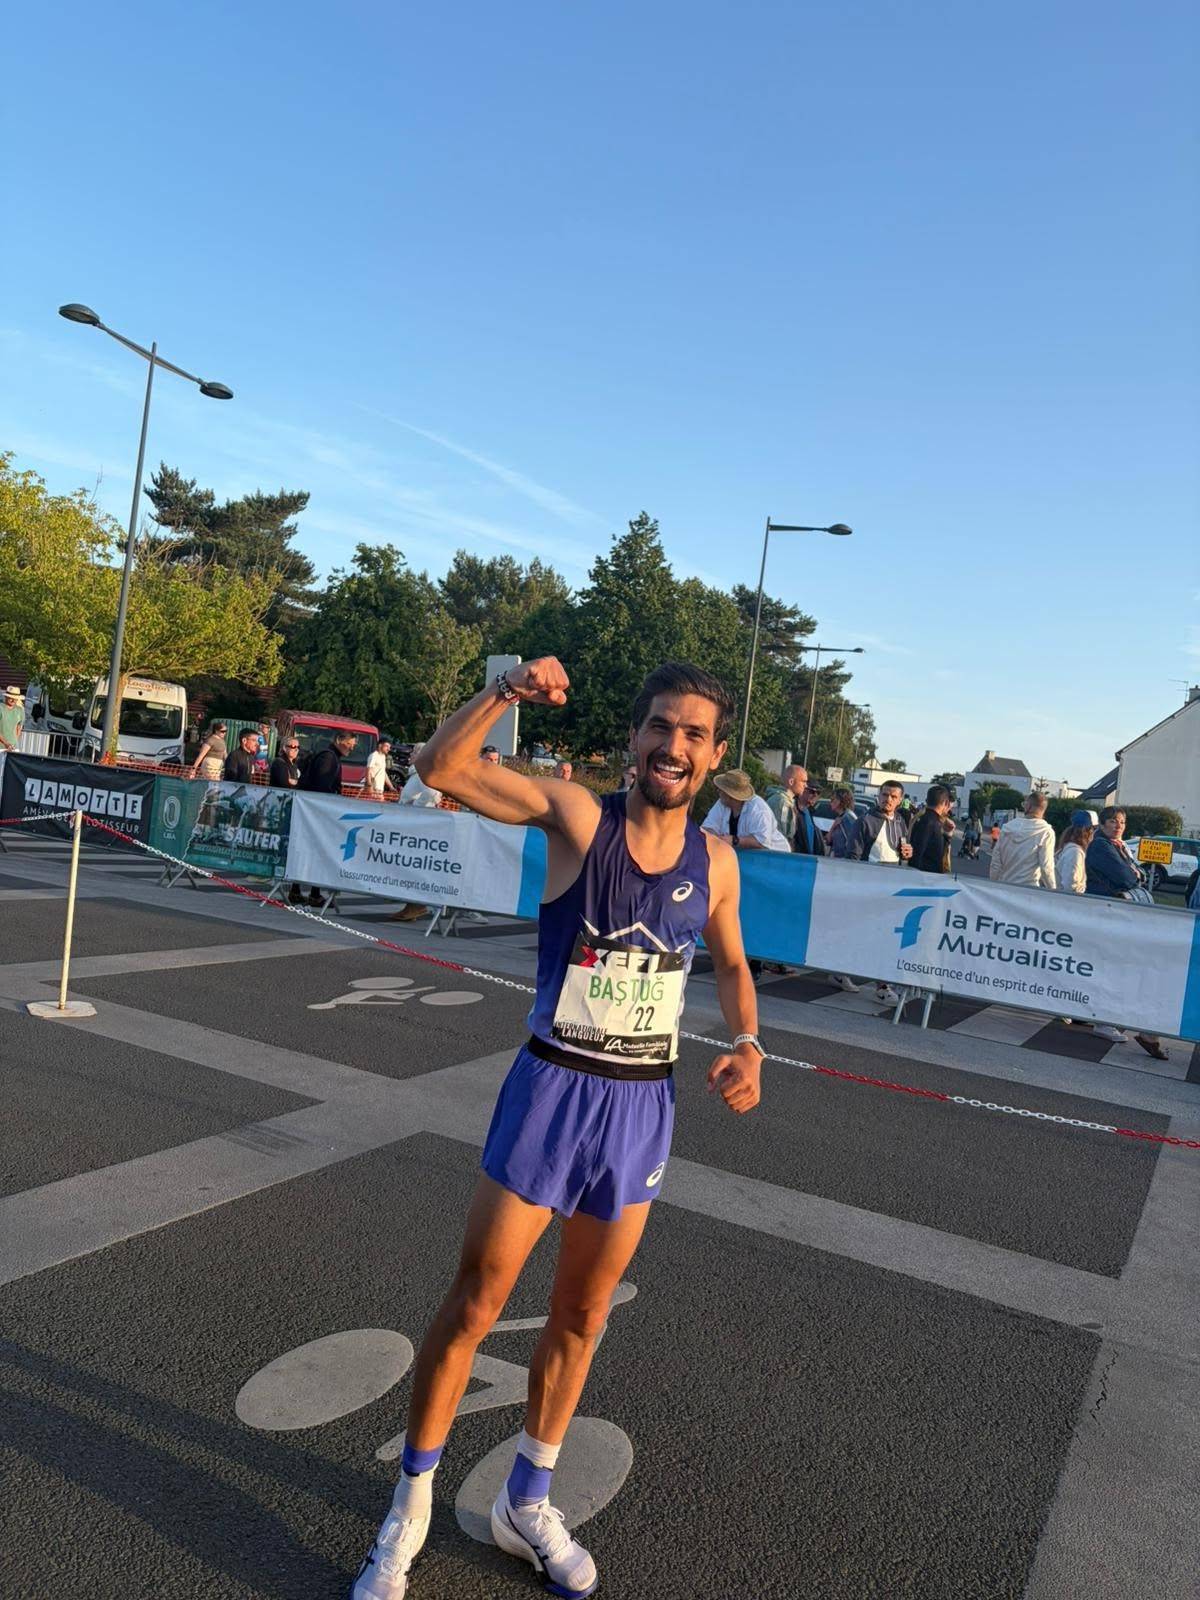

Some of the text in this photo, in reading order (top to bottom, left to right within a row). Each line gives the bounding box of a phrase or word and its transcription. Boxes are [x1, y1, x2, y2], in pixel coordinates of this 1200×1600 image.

[27, 781, 140, 816] LAMOTTE
[225, 825, 281, 850] SAUTER
[369, 828, 449, 853] la France
[366, 847, 462, 875] Mutualiste
[340, 868, 459, 896] L'assurance d'un esprit de famille
[944, 909, 1074, 949] la France
[937, 932, 1094, 978] Mutualiste
[589, 975, 665, 1006] BAŞTUĞ
[896, 958, 1090, 1006] L'assurance d'un esprit de famille
[633, 1006, 655, 1032] 22
[562, 1026, 606, 1043] LANGUEUX
